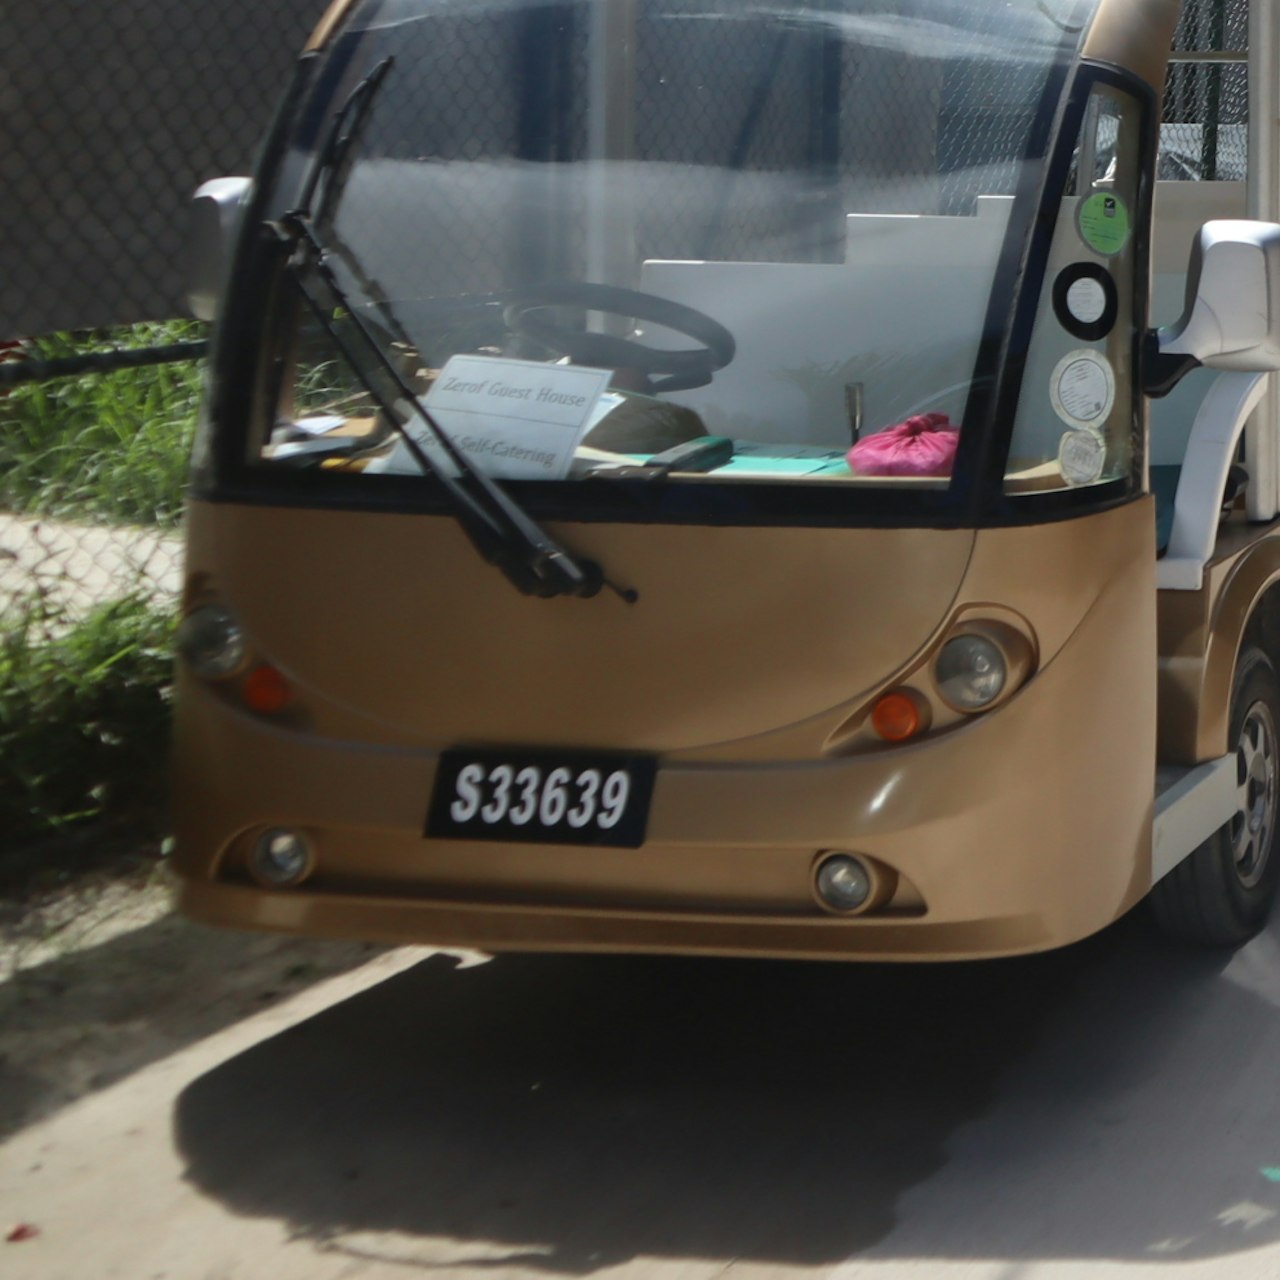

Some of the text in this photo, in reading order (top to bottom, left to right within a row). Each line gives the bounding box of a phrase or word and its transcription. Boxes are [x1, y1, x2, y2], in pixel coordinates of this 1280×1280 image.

[488, 383, 533, 401] Guest
[536, 386, 586, 408] House
[460, 434, 557, 468] Self-Catering
[450, 762, 631, 830] S33639
